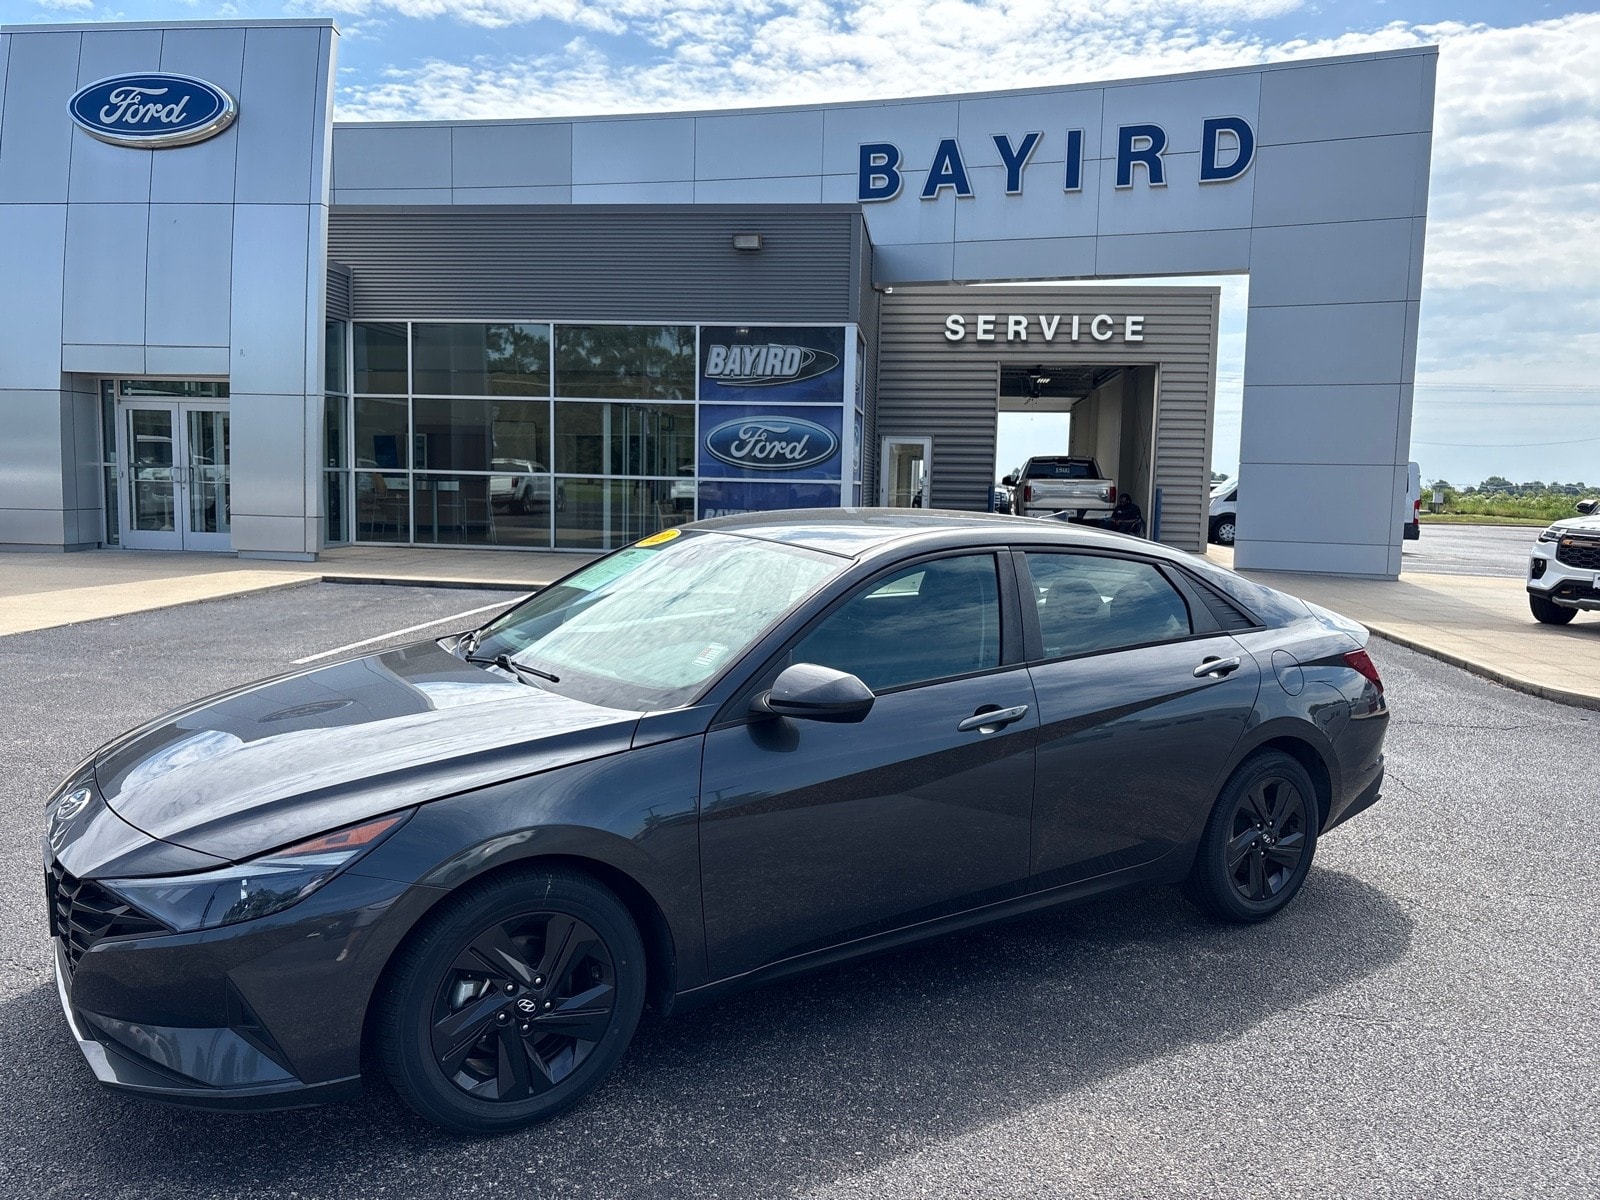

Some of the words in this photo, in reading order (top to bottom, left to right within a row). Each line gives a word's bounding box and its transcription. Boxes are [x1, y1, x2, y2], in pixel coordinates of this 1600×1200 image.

[100, 86, 190, 124] Ford
[857, 114, 1256, 203] BAYIRD
[944, 313, 1145, 342] SERVICE
[706, 345, 803, 377] BAYIRD
[730, 424, 810, 460] Ford
